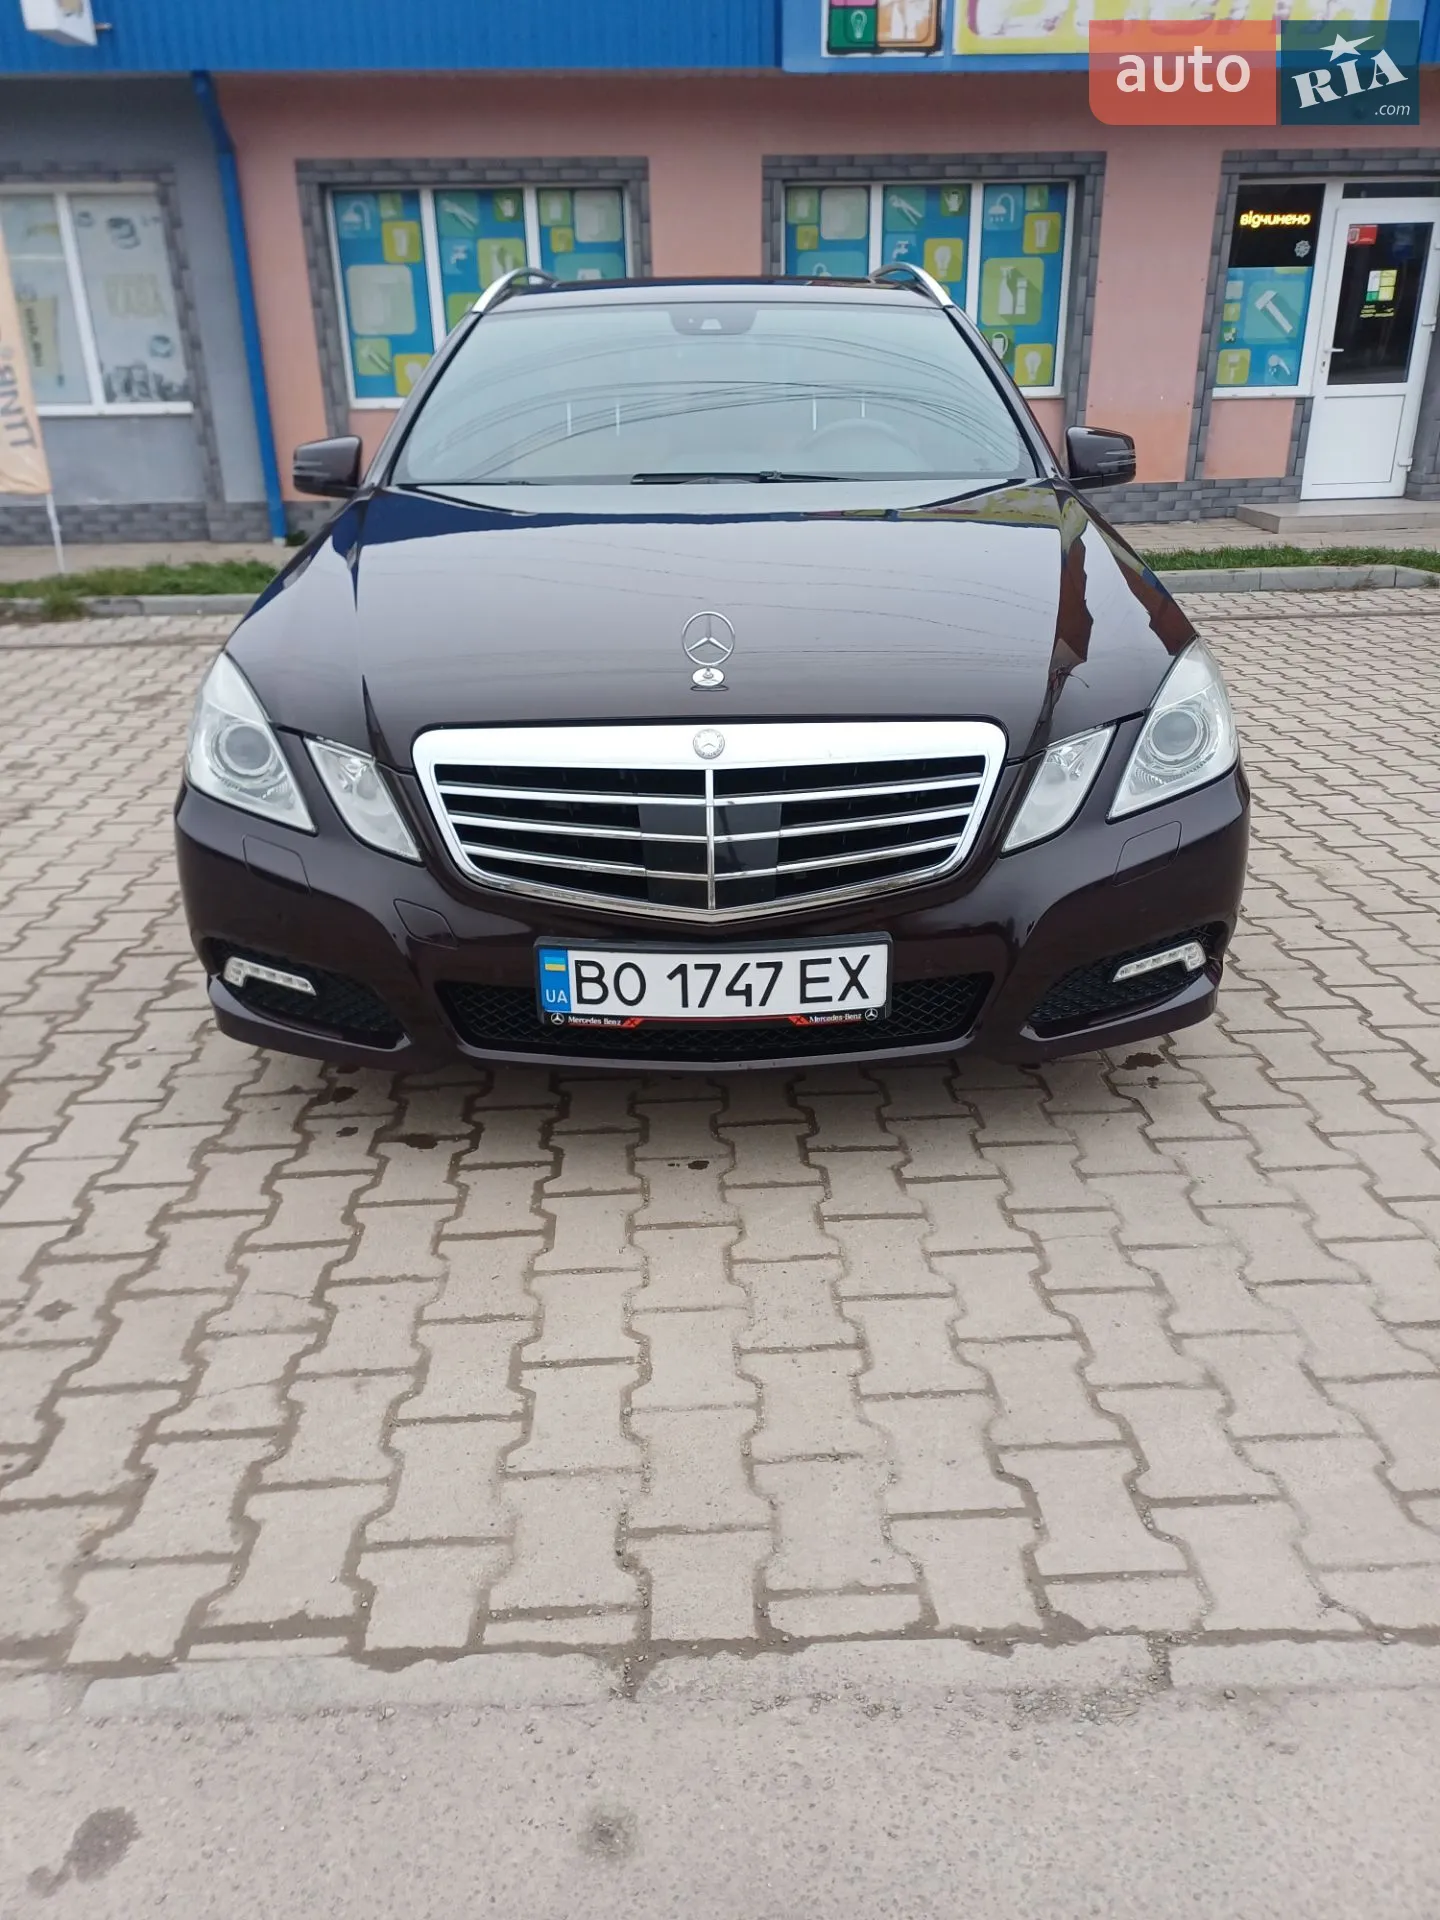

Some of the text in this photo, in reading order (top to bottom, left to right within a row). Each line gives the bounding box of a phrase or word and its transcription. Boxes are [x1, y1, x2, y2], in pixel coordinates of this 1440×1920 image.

[1240, 210, 1311, 228] відчинено
[574, 954, 871, 1008] BO 1747 EX
[546, 989, 568, 1004] UA
